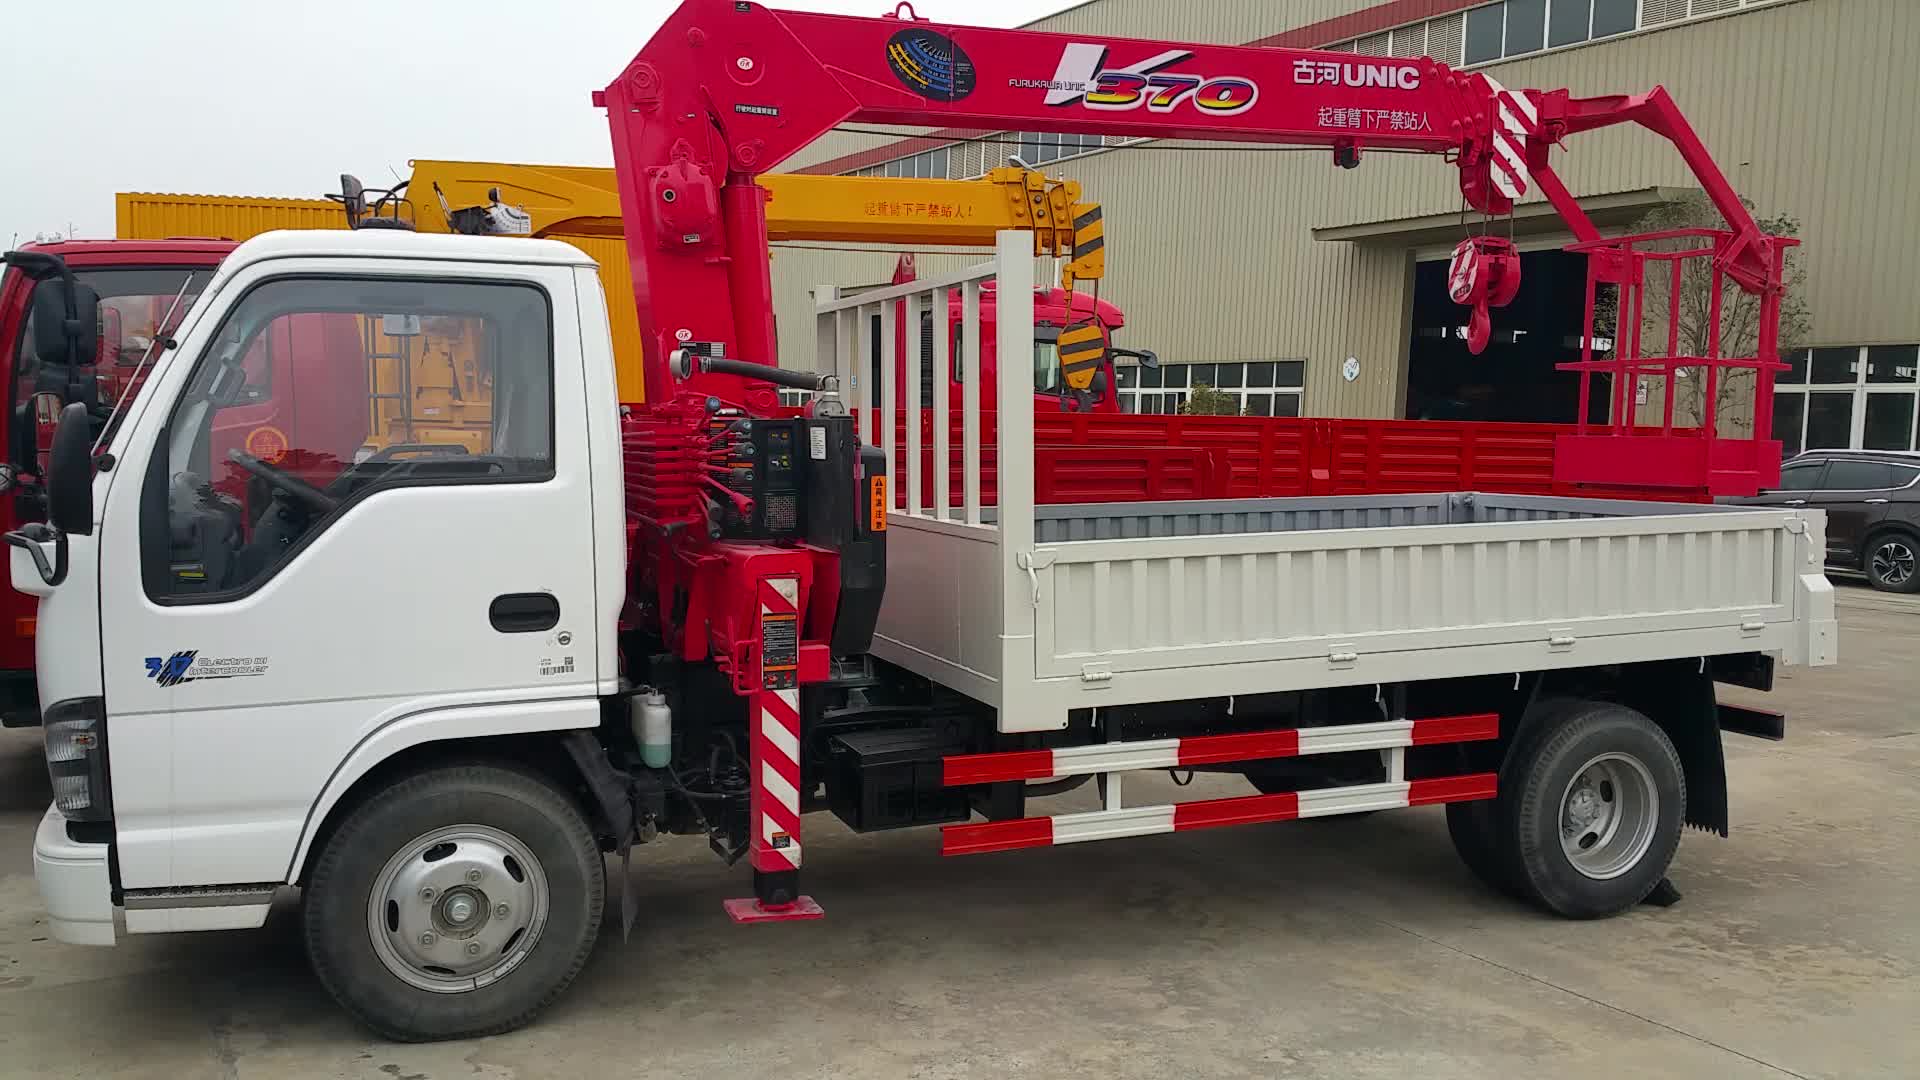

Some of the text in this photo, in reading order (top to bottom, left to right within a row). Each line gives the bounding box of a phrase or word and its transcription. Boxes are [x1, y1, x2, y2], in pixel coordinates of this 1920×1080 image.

[1009, 79, 1062, 89] FURUKAWA
[1318, 106, 1432, 132] 起重臂下严禁站人
